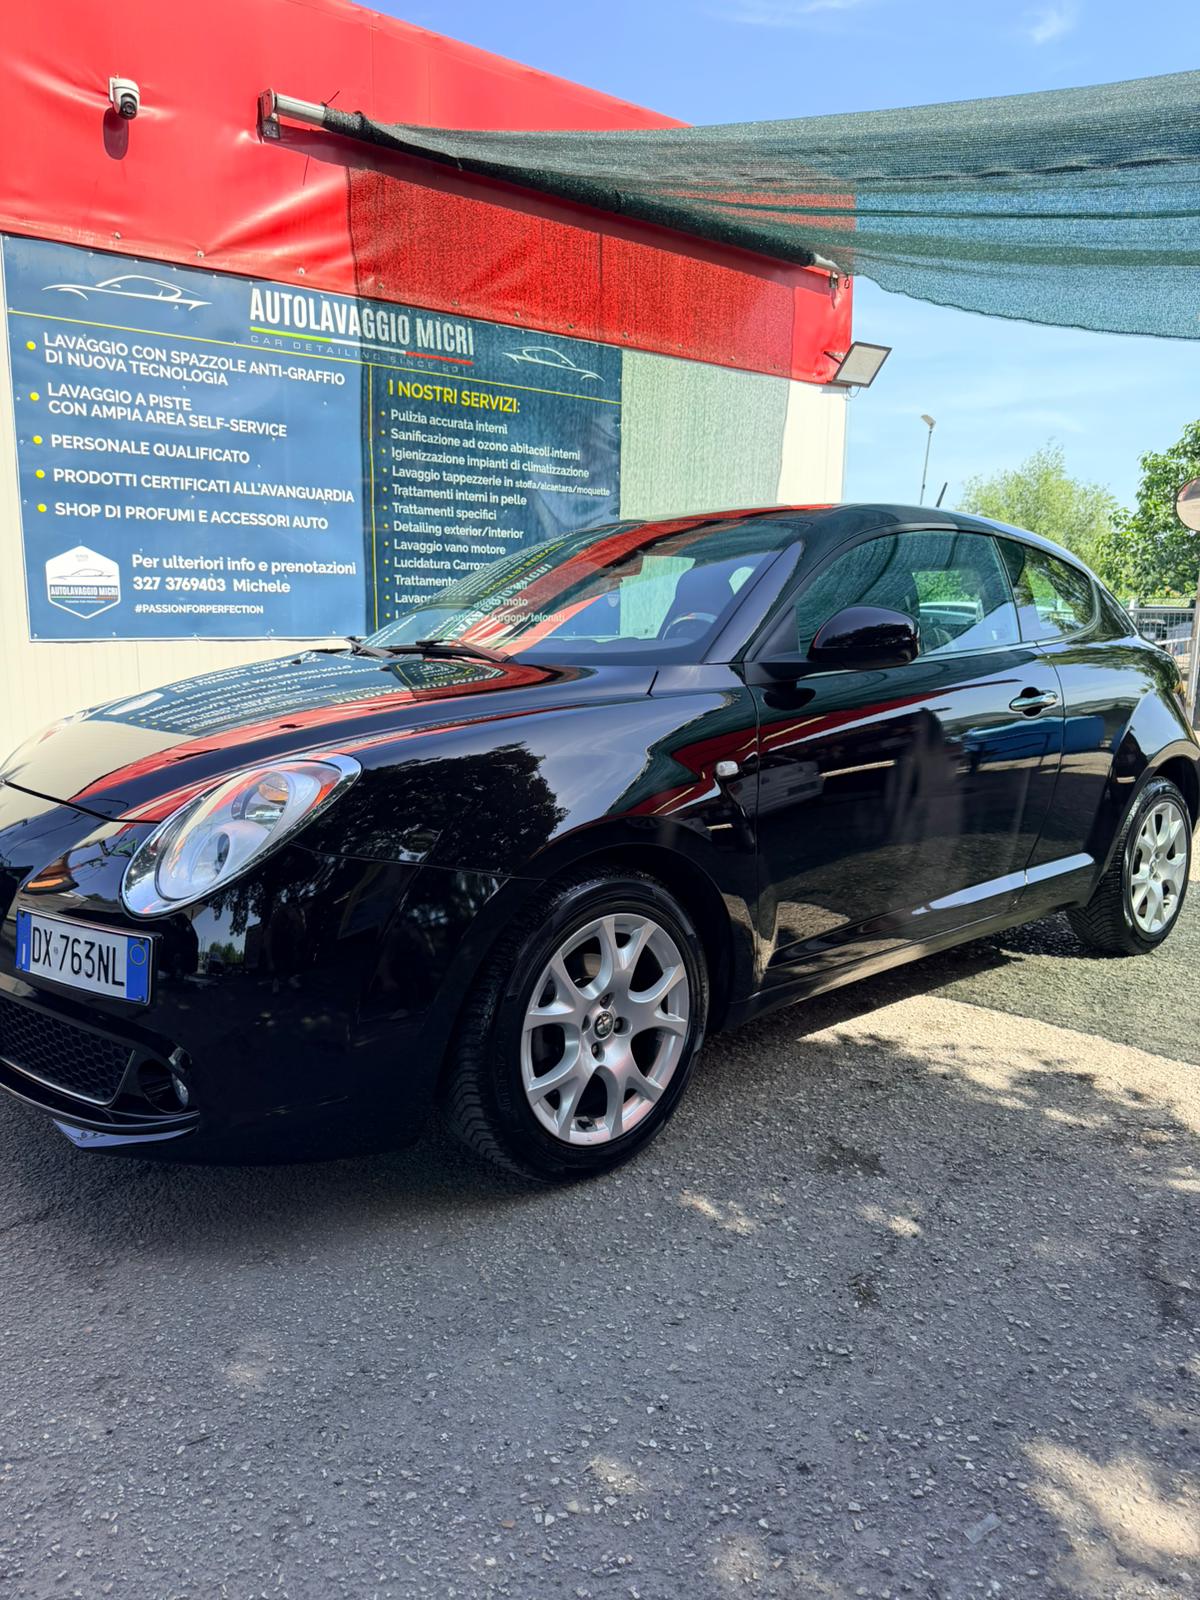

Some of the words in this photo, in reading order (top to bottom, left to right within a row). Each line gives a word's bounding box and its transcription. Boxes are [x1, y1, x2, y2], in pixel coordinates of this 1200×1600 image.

[250, 287, 411, 345] AUTOLAVAGGIO
[416, 318, 474, 356] MICRI
[44, 332, 129, 357] LAVAGGIO
[132, 344, 168, 362] CON
[171, 349, 246, 373] SPAZZOLE
[249, 359, 345, 386] ANTI-GRAFFIO
[250, 335, 283, 347] CAR
[293, 341, 381, 362] DETAILING
[45, 350, 68, 366] DI
[70, 353, 127, 373] NUOVA
[130, 361, 228, 386] TECNOLOGIA
[48, 383, 132, 404] LAVAGGIO
[135, 393, 147, 406] A
[149, 394, 192, 411] PISTE
[388, 379, 393, 395] I
[398, 381, 458, 404] NOSTRI
[461, 391, 521, 413] SERVIZI:
[48, 401, 87, 417] CON
[91, 405, 143, 423] AMPIA
[145, 410, 186, 427] AREA
[189, 415, 287, 438] SELF-SERVICE
[391, 409, 427, 425] Pulizia
[429, 416, 474, 430] accurata
[475, 420, 508, 434] interni
[51, 434, 150, 455] PERSONALE
[153, 443, 250, 464] QUALIFICATO
[391, 428, 461, 447] Sanificazione
[462, 437, 475, 449] ad
[477, 440, 508, 452] ozono
[510, 442, 550, 457] abitacoli
[551, 448, 581, 461] interni
[391, 447, 465, 466] Igienizzazione
[467, 456, 508, 470] impianti
[510, 459, 521, 471] di
[522, 461, 590, 478] climatizzazione
[392, 465, 440, 482] Lavaggio
[442, 471, 502, 488] tappezzerie
[504, 476, 514, 488] in
[53, 468, 137, 487] PRODOTTI
[141, 475, 230, 494] CERTIFICATI
[233, 483, 354, 503] ALL'AVANGUARDIA
[392, 483, 454, 500] Trattamenti
[455, 489, 488, 503] interni
[489, 491, 499, 503] in
[501, 494, 527, 507] pelle
[55, 502, 101, 518] SHOP
[105, 505, 121, 519] DI
[125, 507, 195, 523] PROFUMI
[198, 511, 208, 523] E
[210, 511, 290, 528] ACCESSORI
[293, 515, 328, 530] AUTO
[392, 502, 454, 518] Trattamenti
[456, 508, 497, 522] specifici
[394, 521, 442, 536] Detailing
[444, 526, 524, 540] exterior/interior
[394, 539, 443, 554] Lavaggio
[444, 544, 469, 553] vano
[471, 545, 506, 555] motore
[132, 554, 160, 569] Per
[163, 555, 224, 571] ulteriori
[227, 557, 256, 572] info
[259, 562, 268, 572] e
[271, 560, 356, 576] prenotazioni
[394, 556, 451, 570] Lucidatura
[133, 577, 160, 591] 327
[165, 577, 226, 593] 3769403
[233, 578, 290, 593] Michele
[135, 603, 264, 615] #PASSIONFORPERFECTION
[32, 926, 52, 968] DX
[59, 934, 125, 987] 763NL
